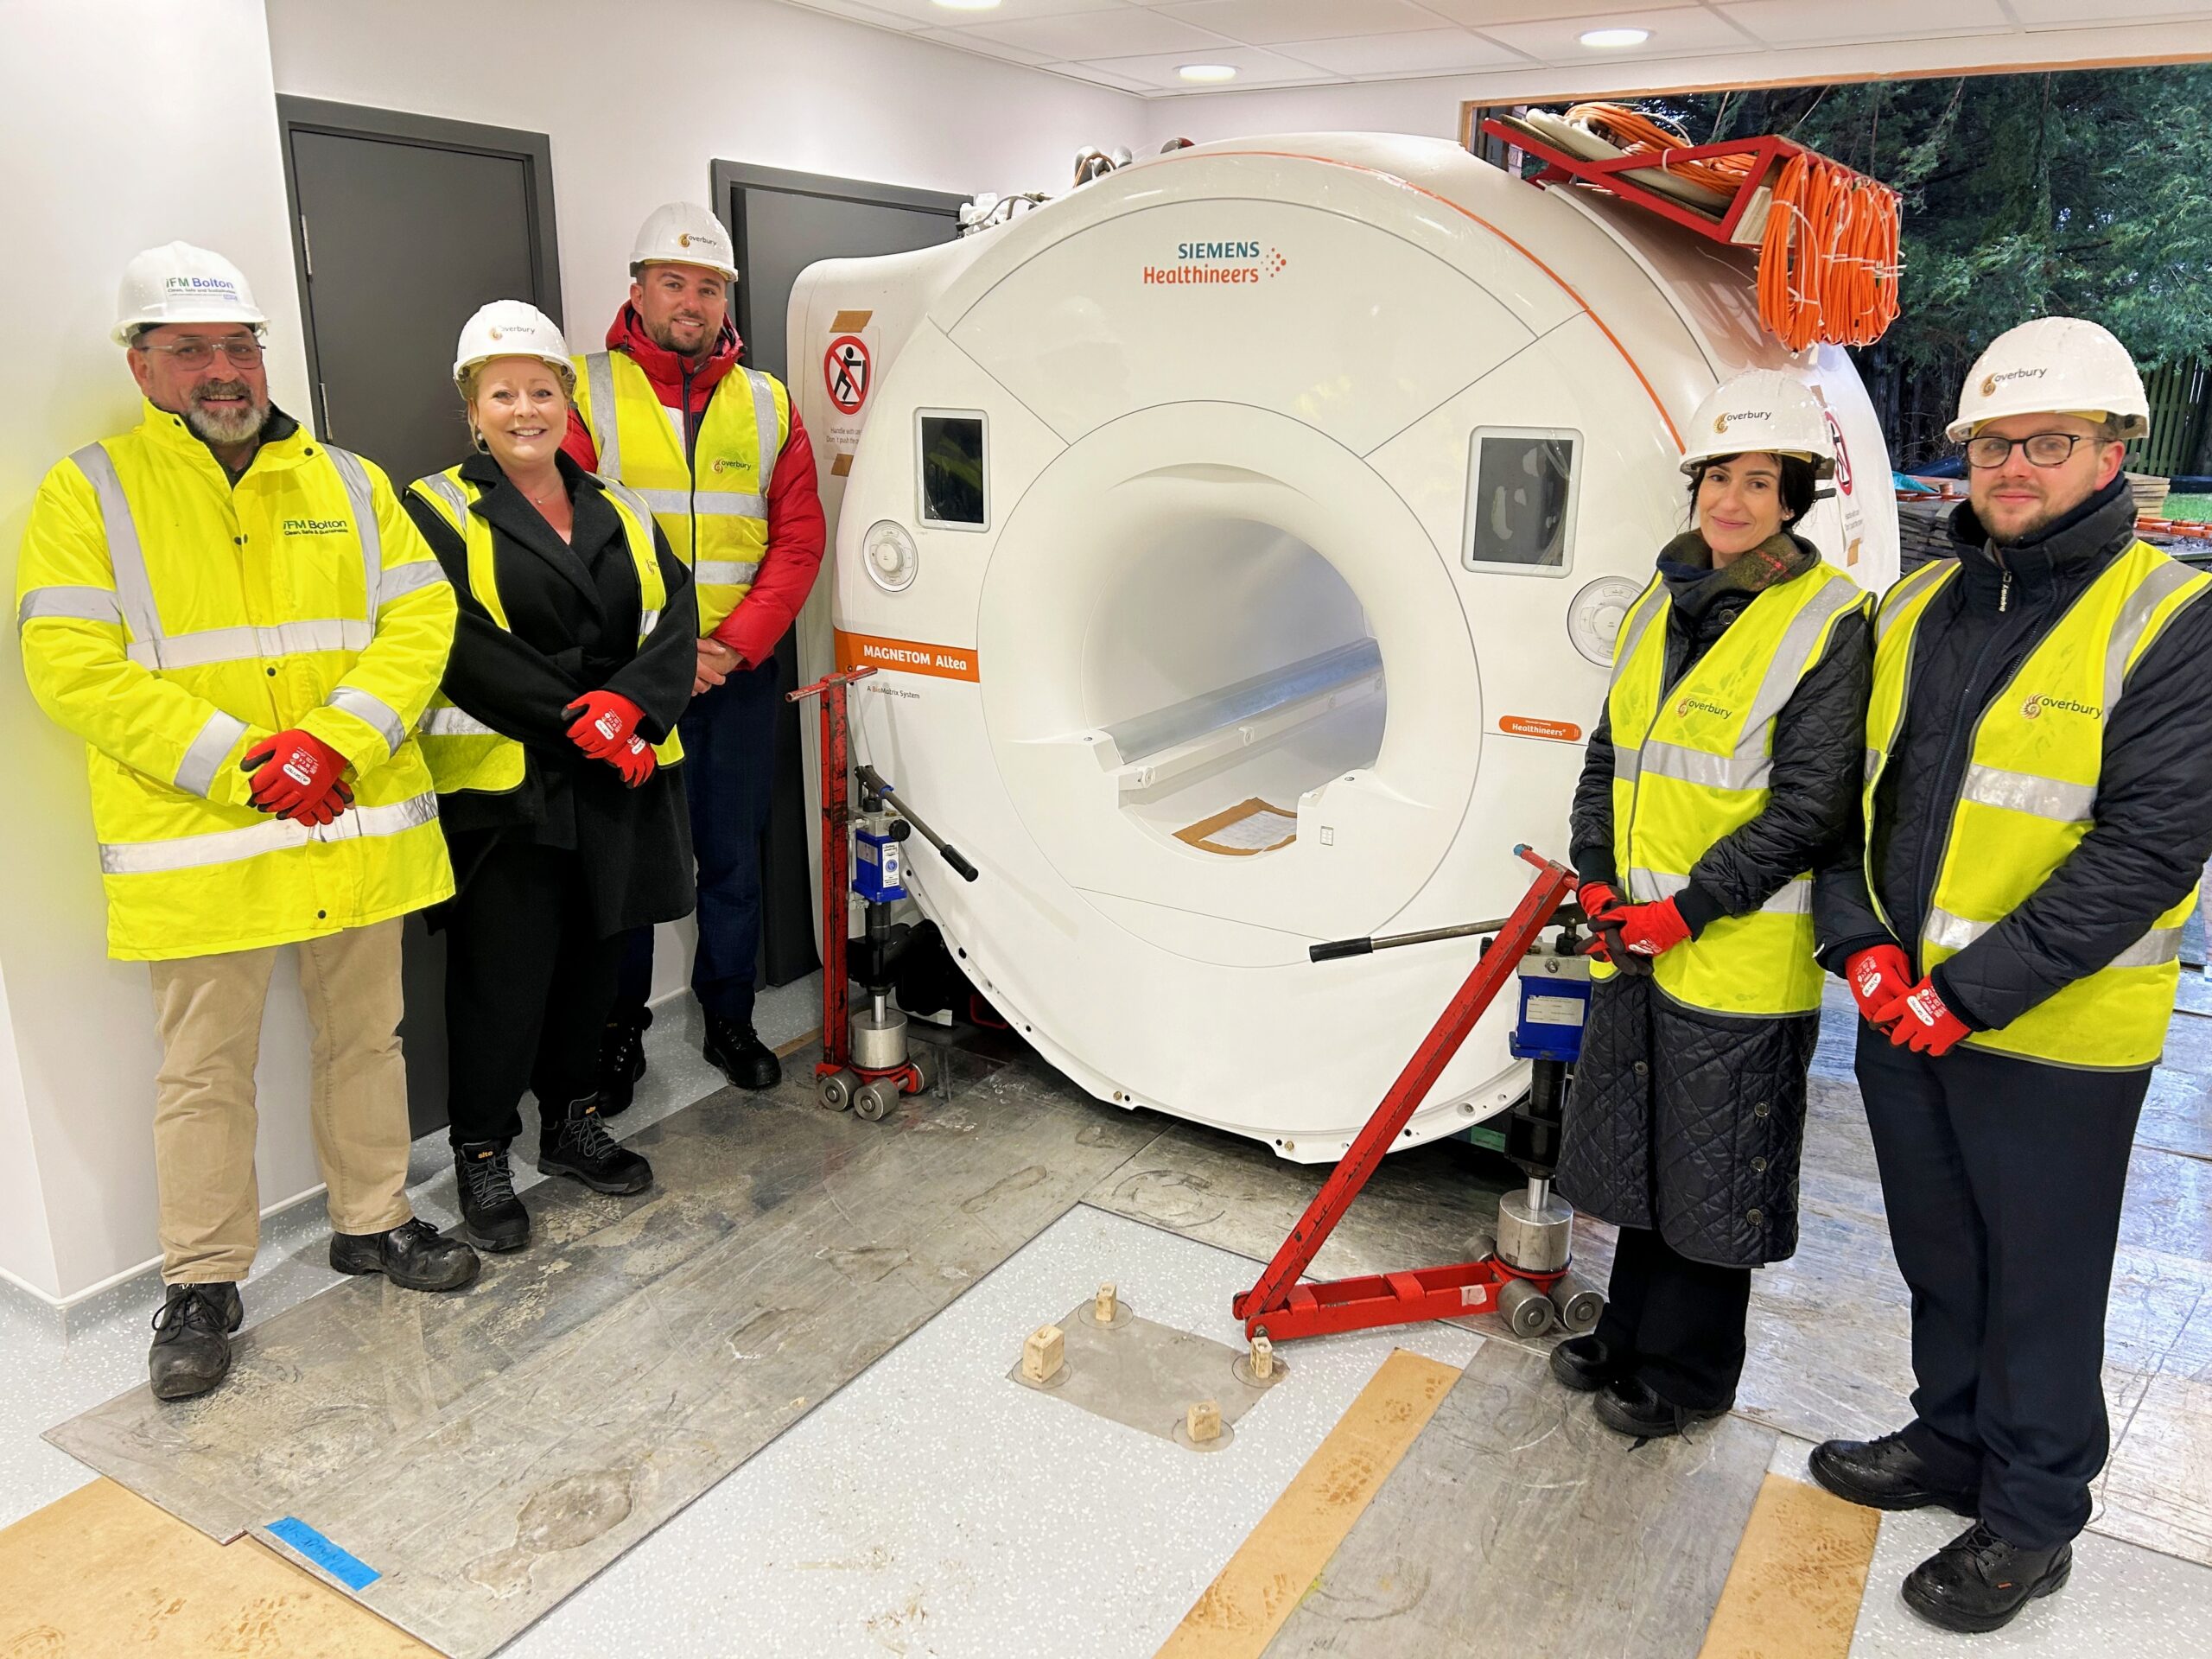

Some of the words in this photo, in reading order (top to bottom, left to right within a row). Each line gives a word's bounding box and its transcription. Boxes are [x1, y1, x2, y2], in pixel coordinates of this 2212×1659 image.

[689, 235, 717, 247] overbury
[1178, 241, 1260, 259] SIEMENS
[1143, 263, 1259, 284] Healthineers
[165, 277, 189, 289] iFM
[191, 277, 234, 289] Bolton
[1993, 367, 2047, 382] overbury
[1726, 410, 1772, 422] overbury
[721, 460, 752, 471] overbury
[283, 519, 306, 530] iFM
[308, 519, 347, 529] Bolton
[863, 644, 931, 665] MAGNETOM
[935, 654, 967, 671] Altea
[872, 685, 899, 696] BioMatrix
[899, 690, 920, 699] System
[1688, 699, 1732, 720] overbury
[2041, 696, 2103, 720] overbury
